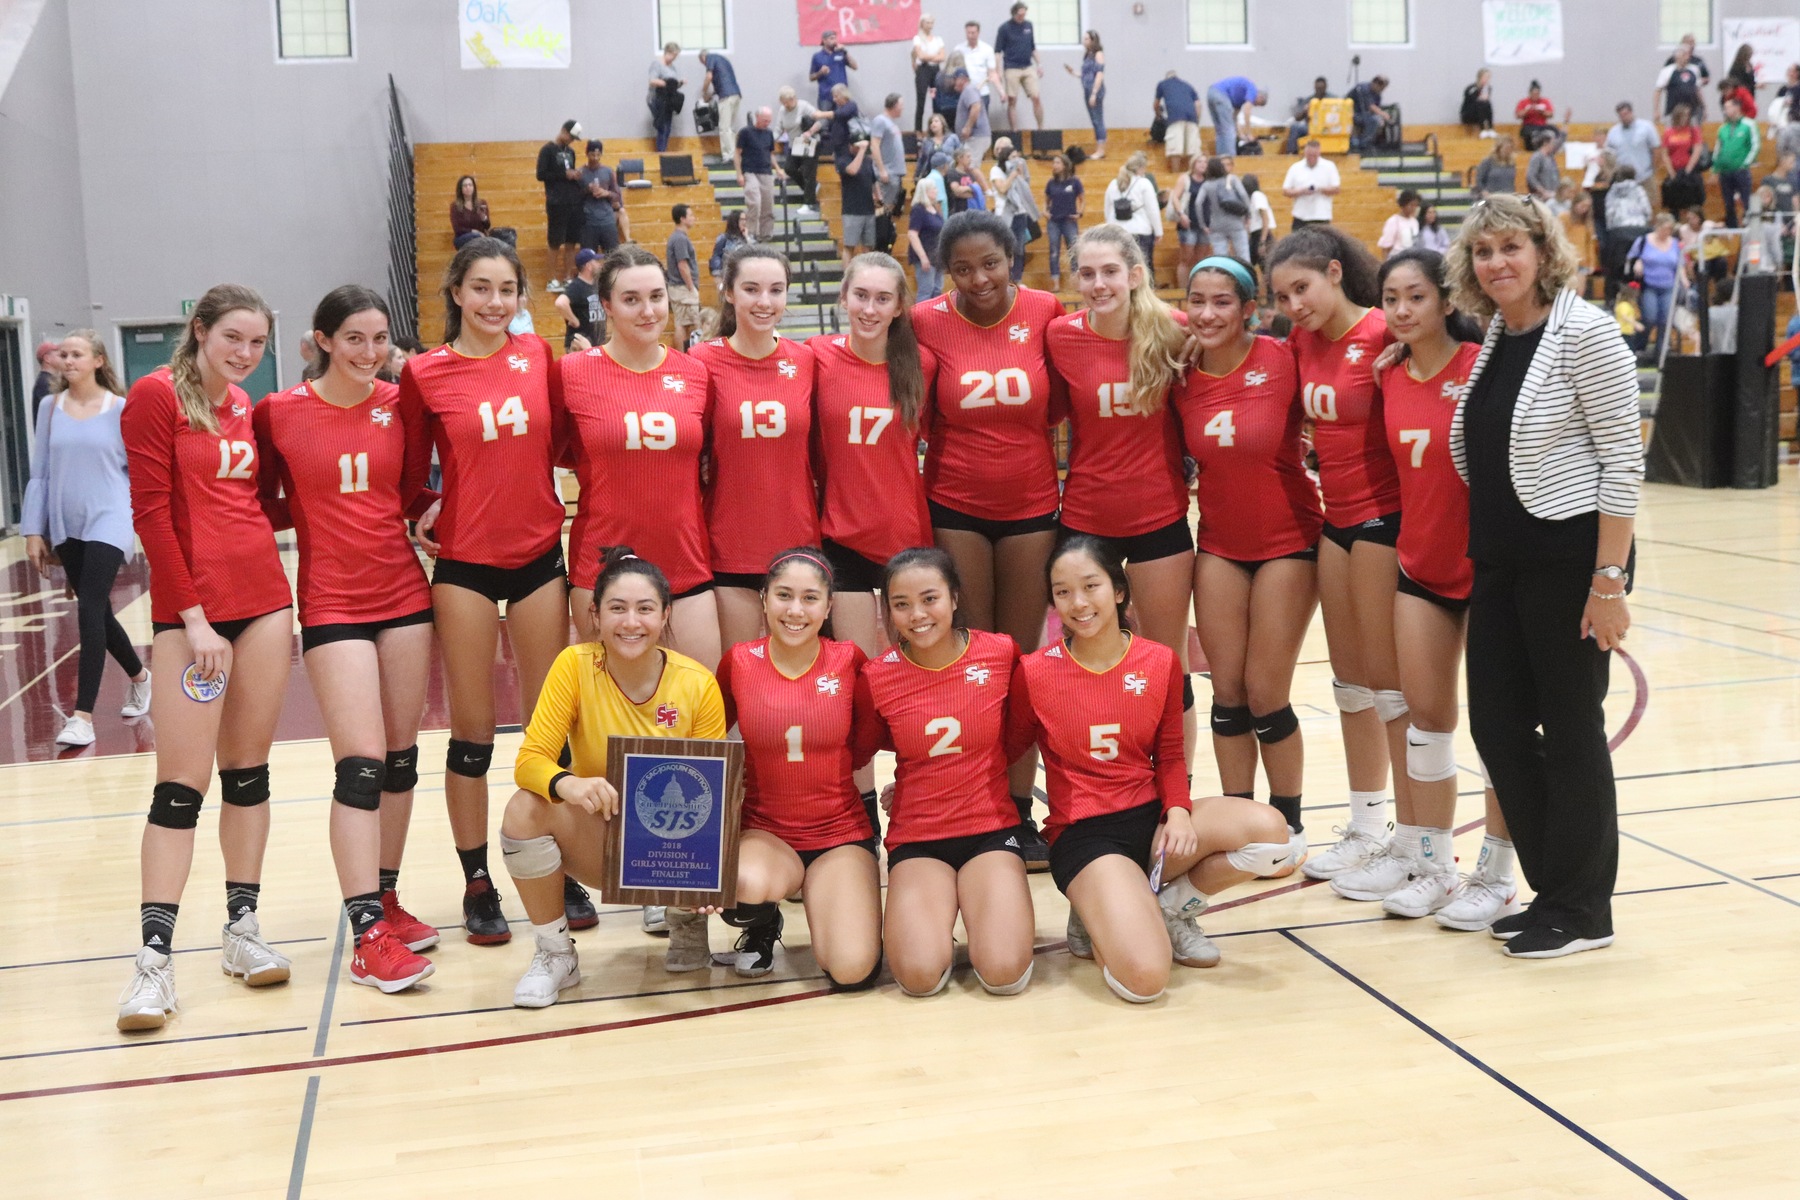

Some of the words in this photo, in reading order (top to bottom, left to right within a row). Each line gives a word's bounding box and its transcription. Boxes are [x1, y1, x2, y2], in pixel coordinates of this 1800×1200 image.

[466, 0, 513, 23] Oak
[503, 23, 565, 58] Ridge
[960, 367, 1032, 409] 20
[1097, 381, 1142, 418] 15
[1303, 382, 1338, 422] 10
[478, 395, 530, 442] 14
[623, 411, 677, 451] 19
[739, 400, 787, 439] 13
[847, 405, 894, 446] 17
[1204, 410, 1236, 447] 4
[215, 438, 255, 479] 12
[1399, 428, 1431, 468] 7
[338, 452, 370, 494] 11
[816, 674, 841, 696] SF
[965, 665, 990, 686] SF
[1124, 673, 1148, 696] SF
[656, 703, 678, 728] SF
[785, 725, 804, 763] 1
[924, 716, 963, 758] 2
[1089, 723, 1121, 761] 5
[687, 768, 710, 794] SECTION
[650, 810, 699, 832] SJS
[648, 850, 688, 860] DIVISION
[661, 841, 682, 850] 2018
[631, 859, 656, 868] GIRLS
[658, 861, 711, 870] VOLLEYBALL
[651, 870, 690, 879] FINALIST
